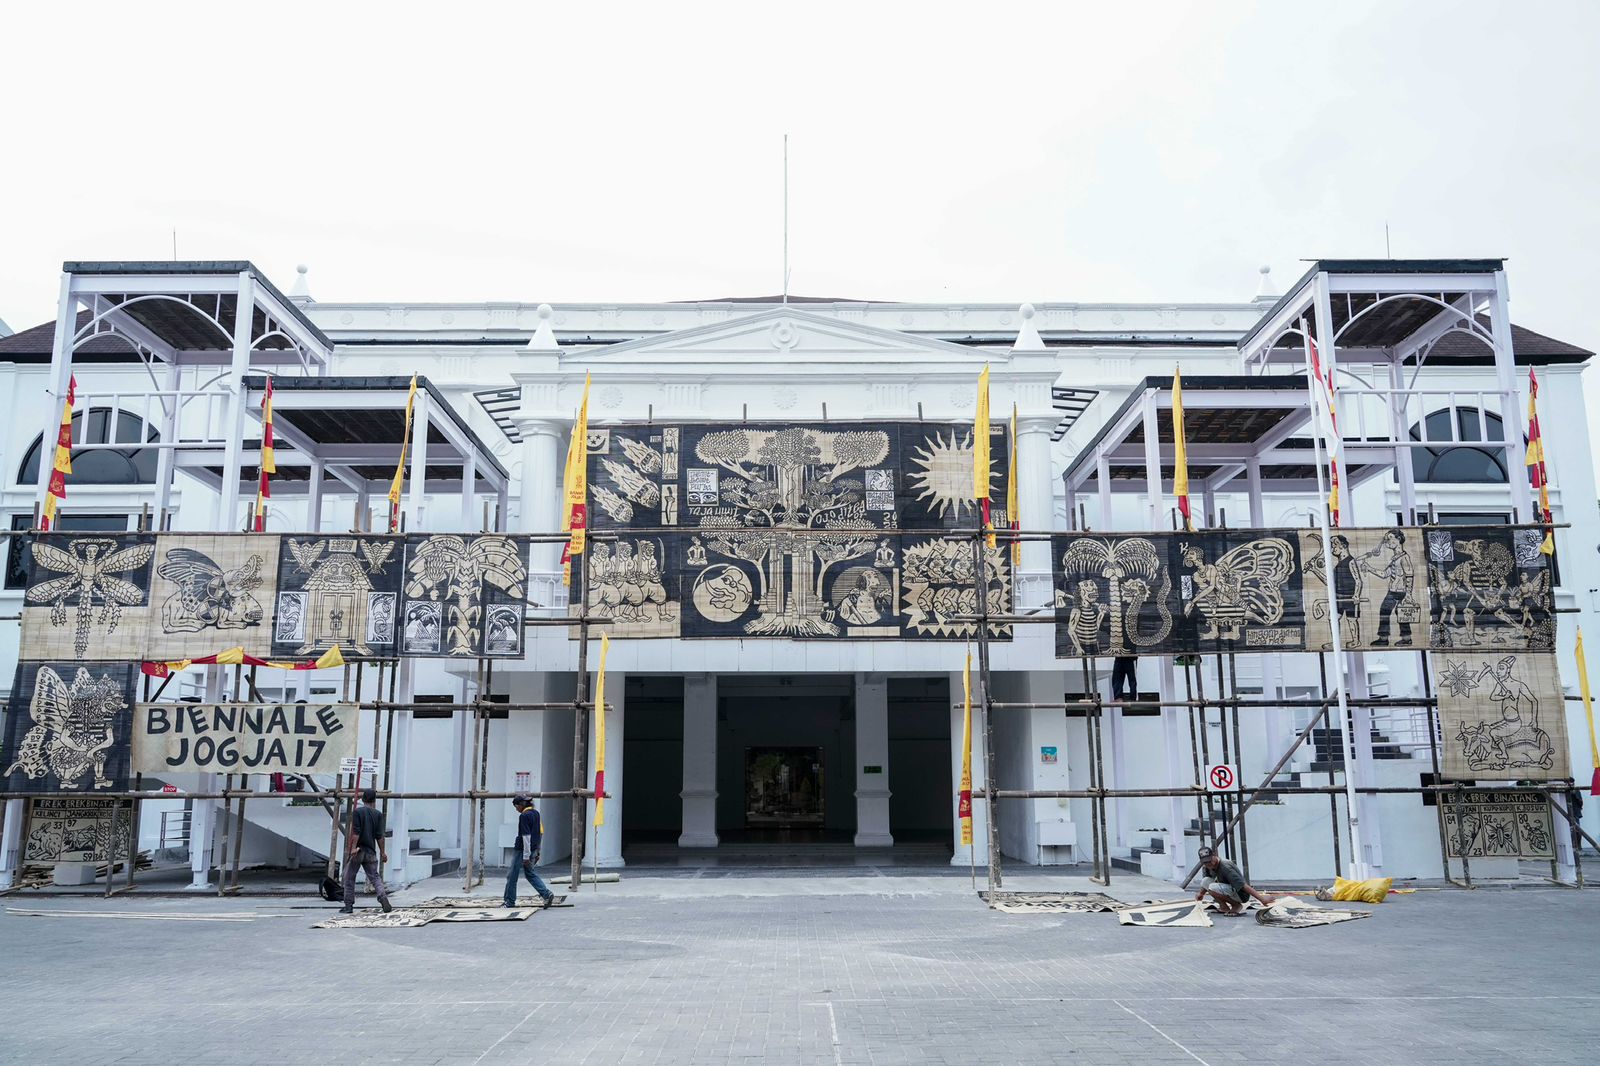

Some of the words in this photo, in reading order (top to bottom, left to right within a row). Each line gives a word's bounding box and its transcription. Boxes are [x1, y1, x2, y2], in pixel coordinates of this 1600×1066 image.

[147, 705, 344, 736] BIENNALE
[166, 736, 287, 767] JOGJA
[295, 739, 326, 767] 17
[1493, 793, 1537, 803] BINATANG
[86, 799, 123, 808] BINATAG
[67, 819, 77, 827] 97
[1518, 813, 1528, 824] 80
[53, 821, 63, 829] 33
[27, 842, 36, 851] 86
[1473, 847, 1483, 855] 23
[82, 853, 93, 861] 59
